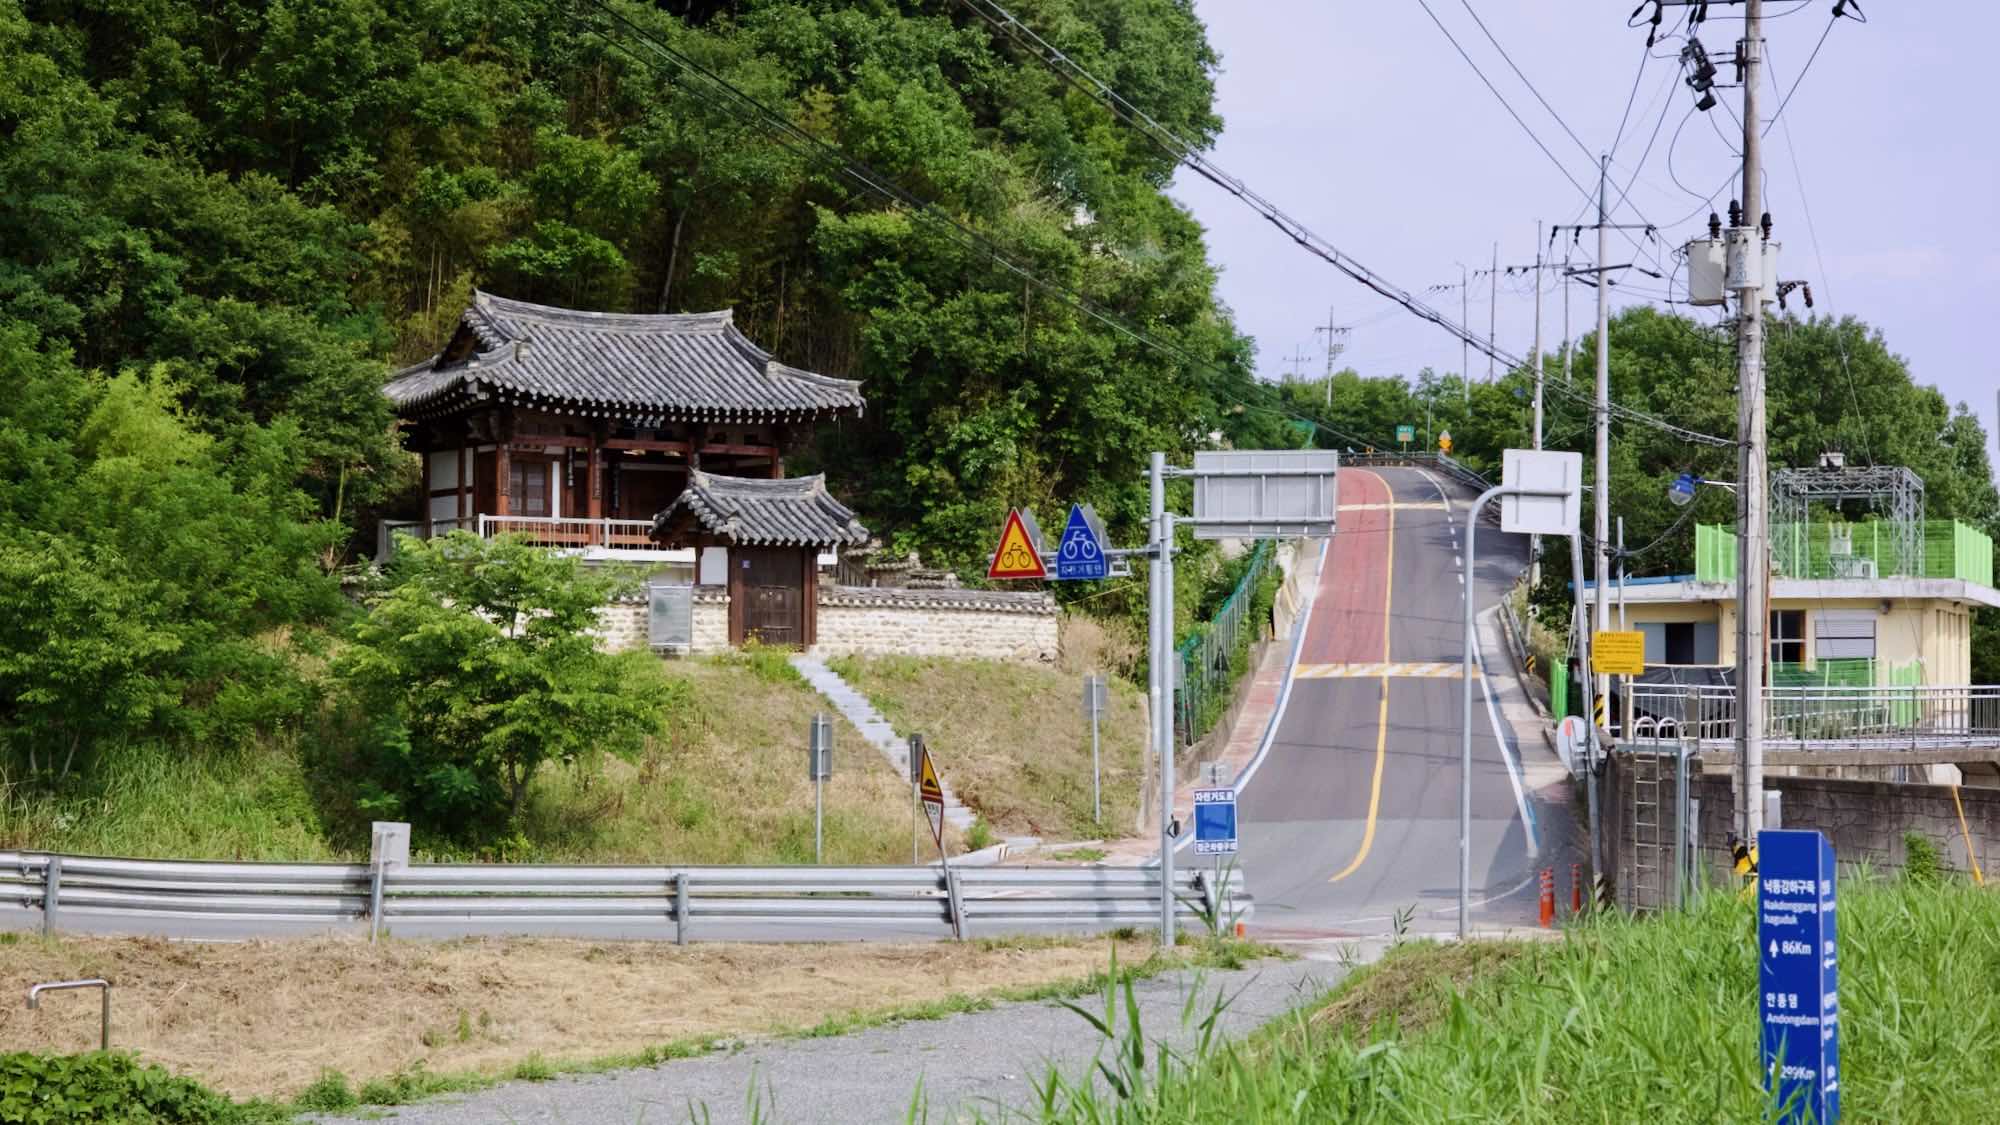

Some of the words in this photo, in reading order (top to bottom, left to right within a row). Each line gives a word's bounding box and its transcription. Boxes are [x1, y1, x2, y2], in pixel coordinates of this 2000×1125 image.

[1764, 879, 1816, 896] 낙동강하구둑
[1782, 939, 1812, 955] 86Km
[1766, 1013, 1820, 1027] Andongdam
